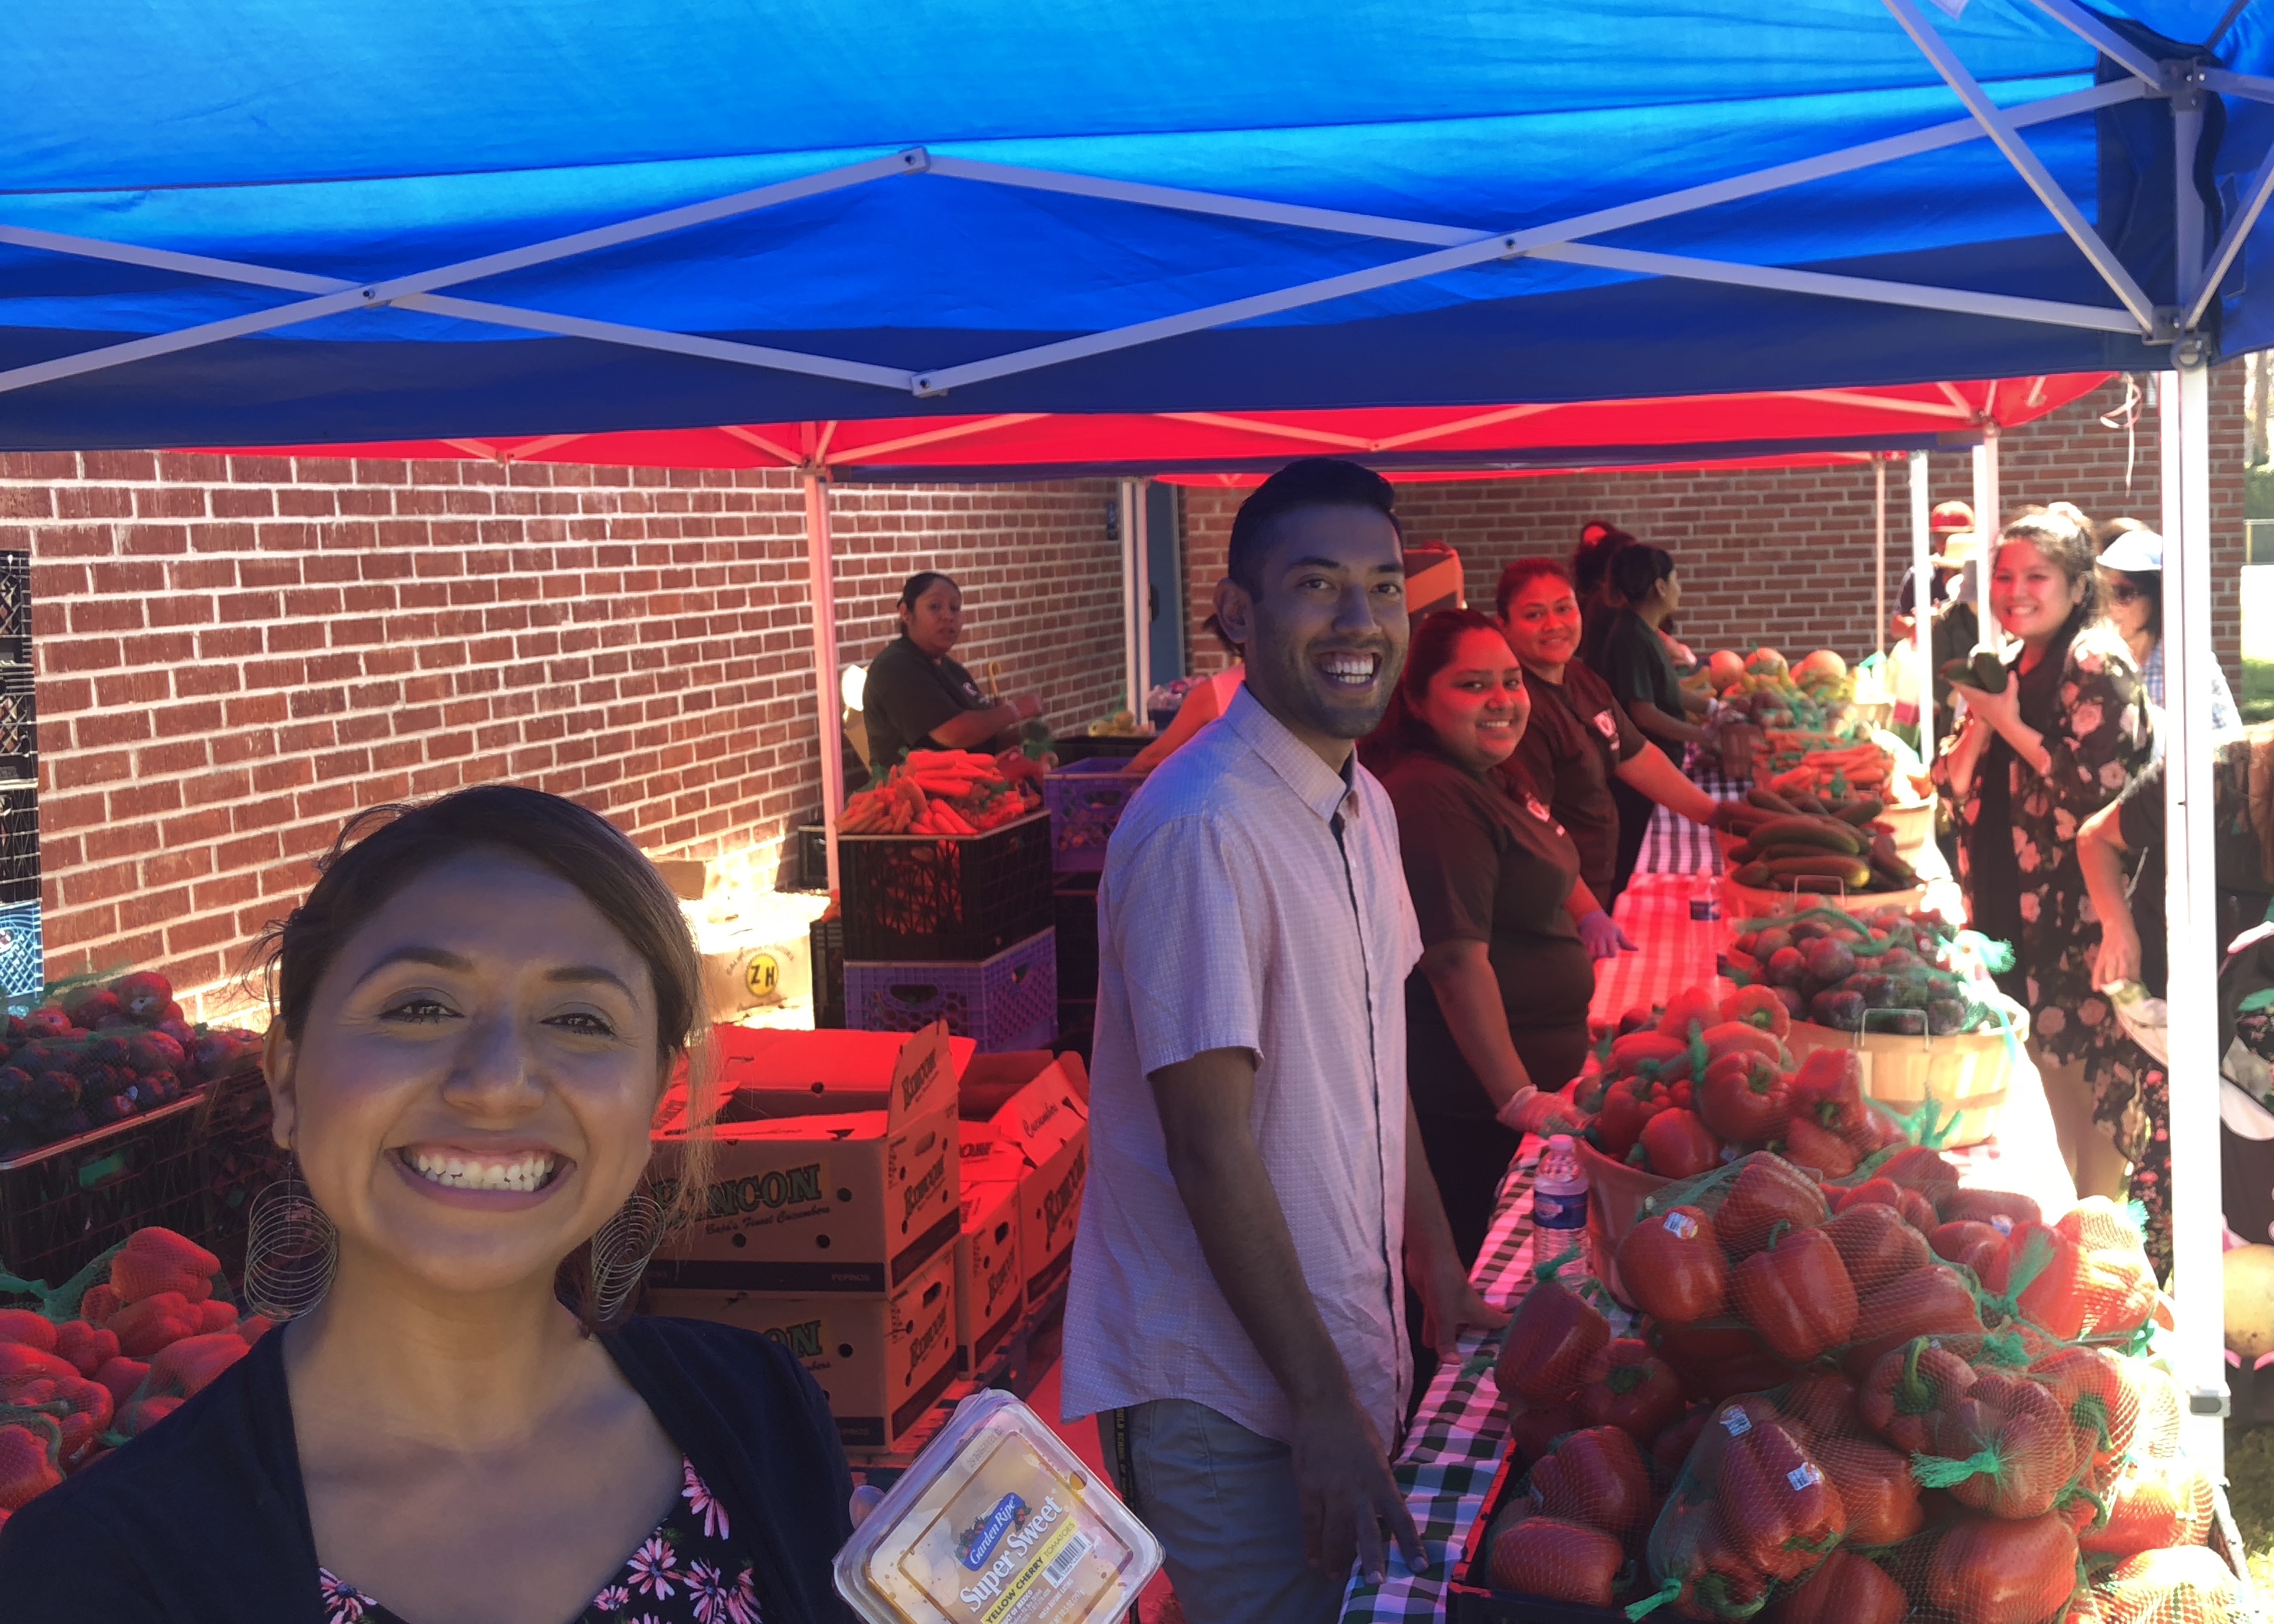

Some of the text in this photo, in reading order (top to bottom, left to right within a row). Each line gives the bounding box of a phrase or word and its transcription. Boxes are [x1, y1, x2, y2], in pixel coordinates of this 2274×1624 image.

[650, 1163, 822, 1229] RNCON
[742, 1215, 774, 1228] Finest
[776, 1204, 830, 1224] Cucumbers
[960, 1550, 1015, 1613] Super
[1006, 1496, 1063, 1558] Sweet
[970, 1527, 1000, 1565] Garden
[985, 1589, 1016, 1624] YELLOW
[1016, 1556, 1043, 1589] CHERRY
[1043, 1522, 1075, 1558] TOMATOES
[1048, 1592, 1063, 1607] BEFORE
[1059, 1577, 1074, 1594] EATING
[1016, 1589, 1033, 1609] MEXICO
